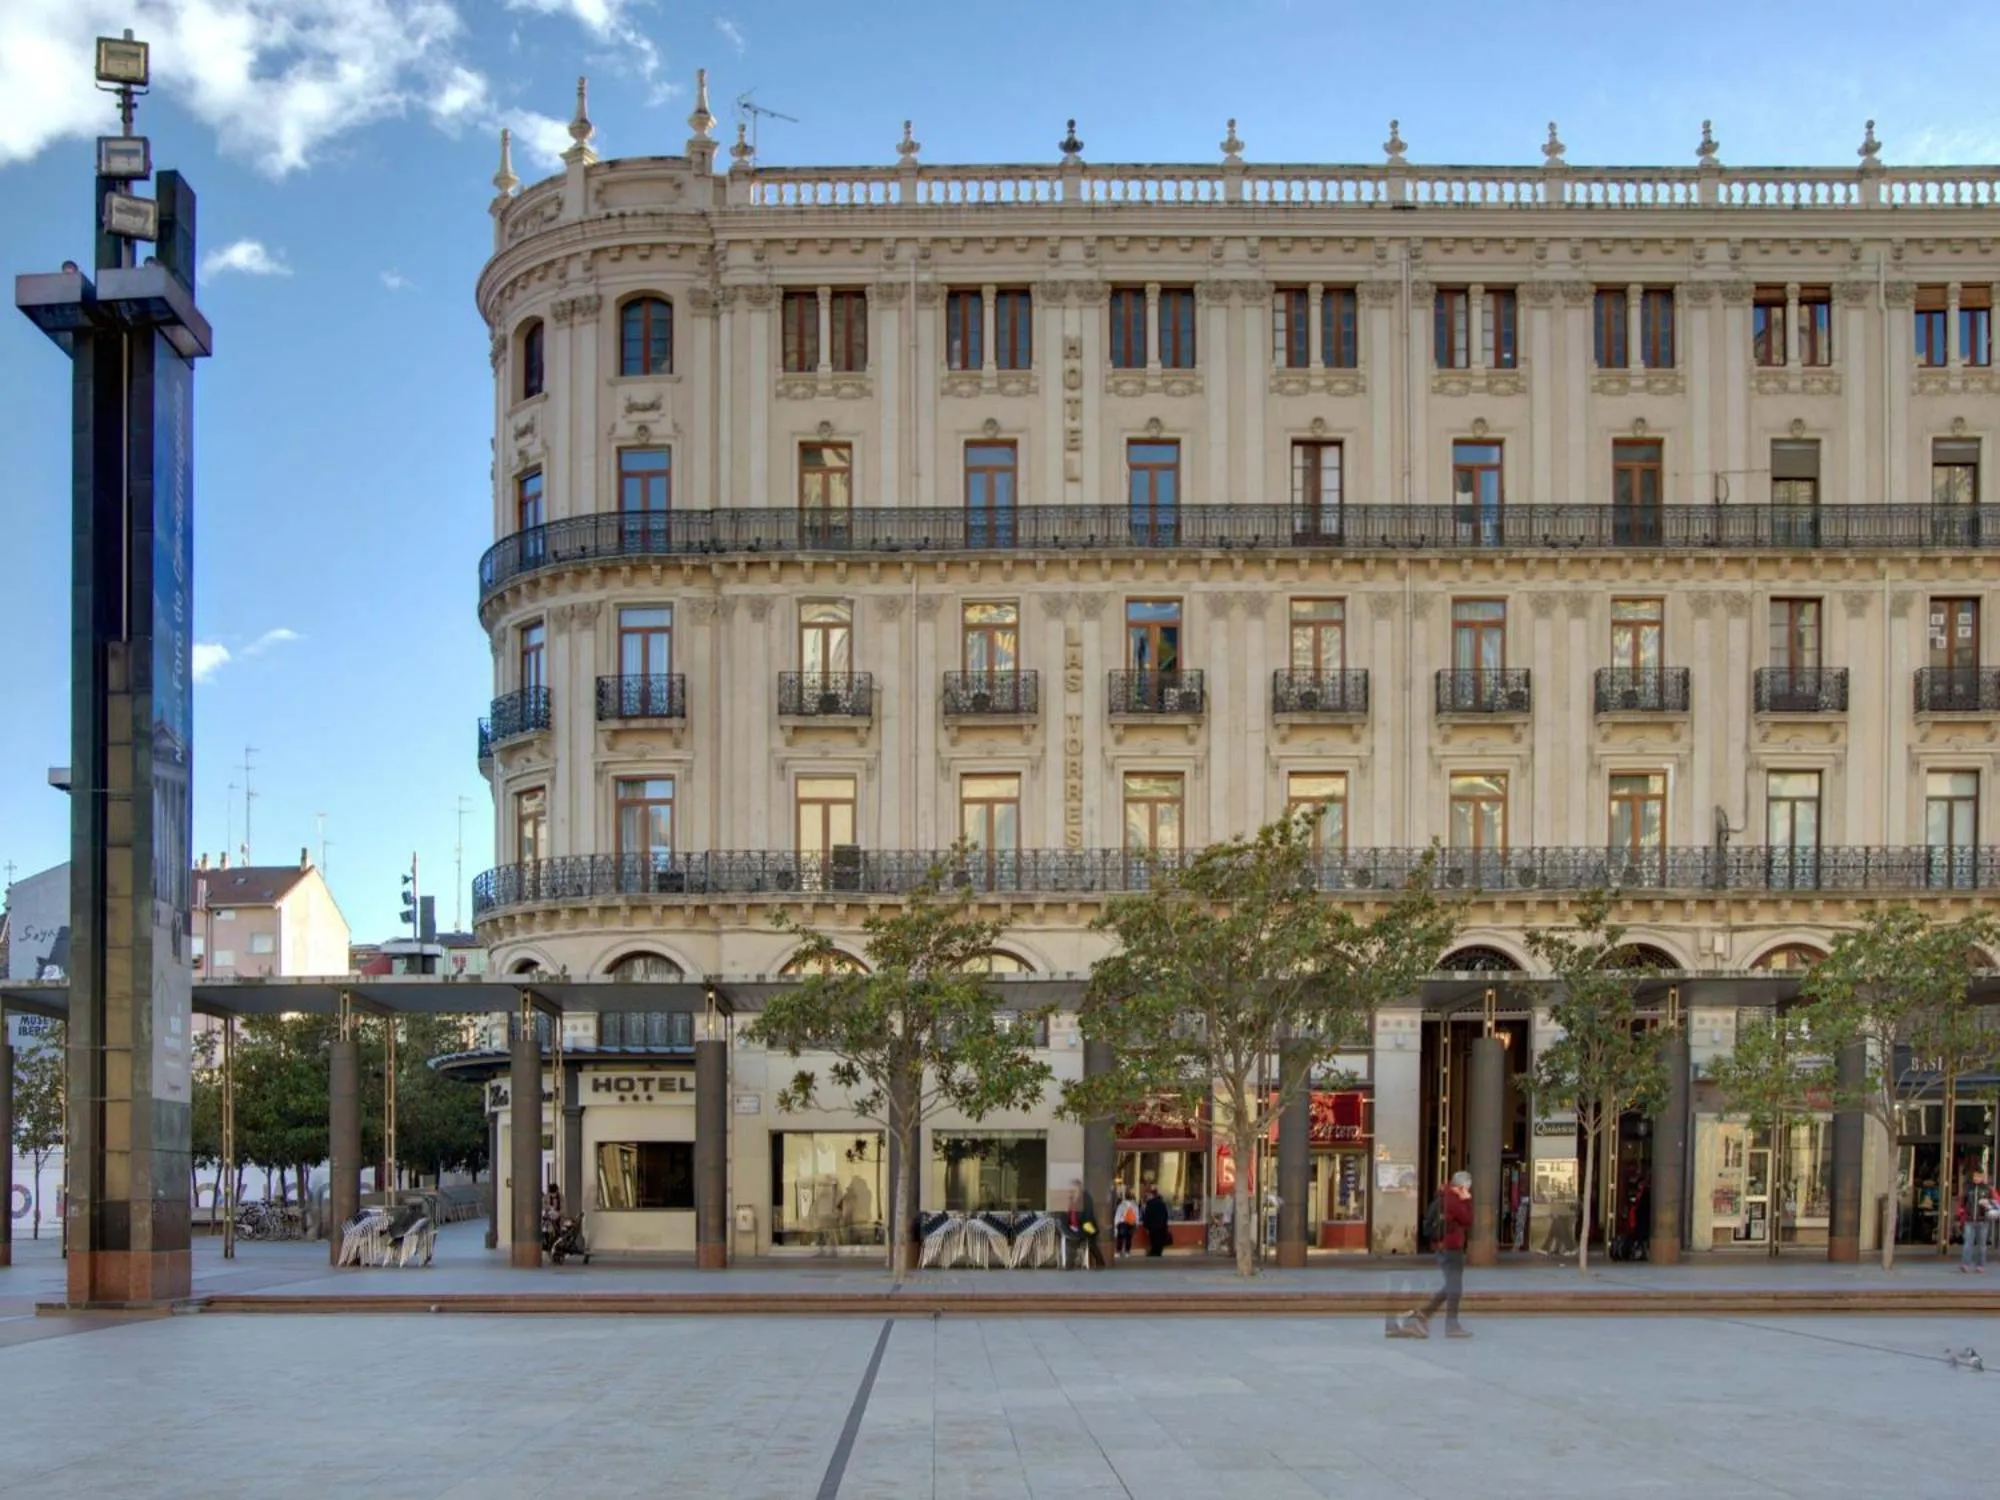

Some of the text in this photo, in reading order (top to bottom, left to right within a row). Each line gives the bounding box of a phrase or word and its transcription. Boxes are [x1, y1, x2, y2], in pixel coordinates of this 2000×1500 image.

[173, 590, 184, 624] de
[172, 630, 184, 692] Foro
[592, 1077, 695, 1093] HOTEL
